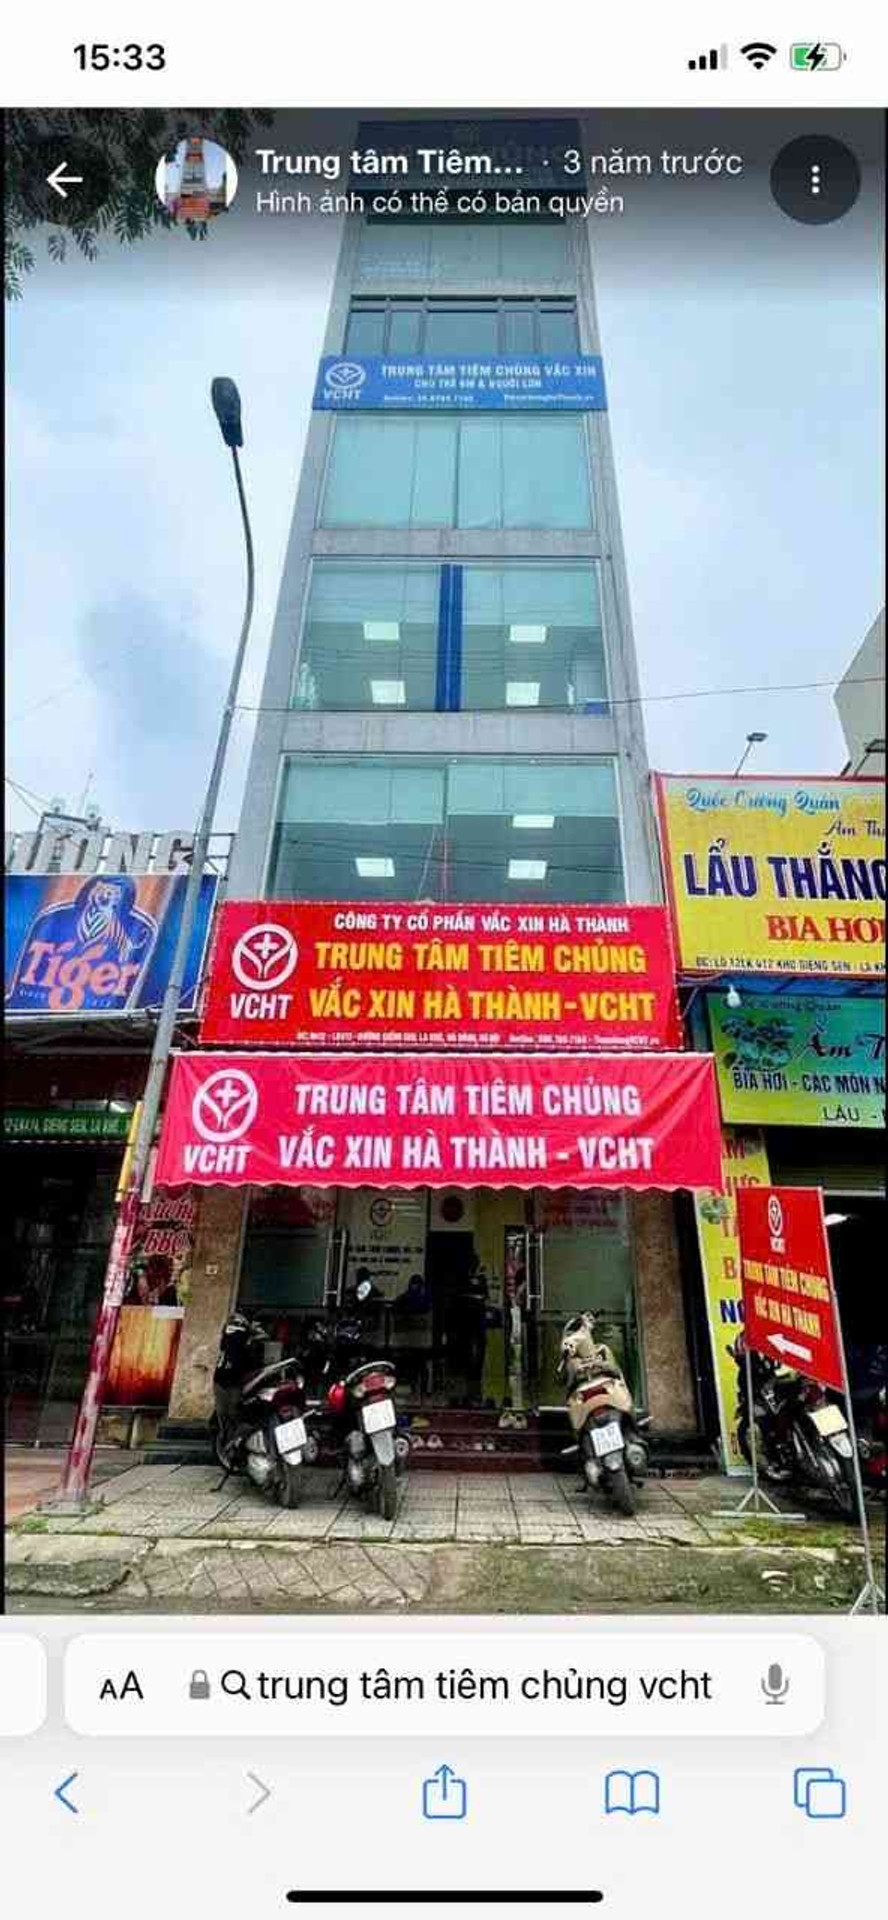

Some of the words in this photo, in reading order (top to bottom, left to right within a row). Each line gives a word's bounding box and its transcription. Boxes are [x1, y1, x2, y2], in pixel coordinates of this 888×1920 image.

[684, 838, 758, 898] LẨU
[334, 910, 377, 930] CÔNG
[383, 913, 402, 930] TY
[517, 915, 545, 932] XIN
[549, 914, 571, 933] HÀ
[765, 914, 822, 942] BIA
[315, 941, 403, 970] TRUNG
[413, 938, 470, 971] TÂM
[478, 938, 545, 972] TIÊM
[553, 938, 647, 973] CHỦNG
[20, 940, 141, 1011] Tiger
[231, 993, 293, 1019] VCHT
[309, 976, 361, 1019] VẮC
[368, 989, 415, 1019] XIN
[423, 984, 462, 1019] HÀ
[295, 1083, 386, 1115] TRUNG
[396, 1078, 455, 1115] TÂM
[464, 1077, 533, 1116] TIÊM
[542, 1076, 642, 1116] CHỦNG
[183, 1144, 253, 1174] VCHT
[278, 1125, 335, 1169] VẮC
[344, 1136, 393, 1169] XIN
[402, 1129, 442, 1169] HÀ
[450, 1129, 548, 1169] THÀNH
[577, 1136, 655, 1170] VCHT
